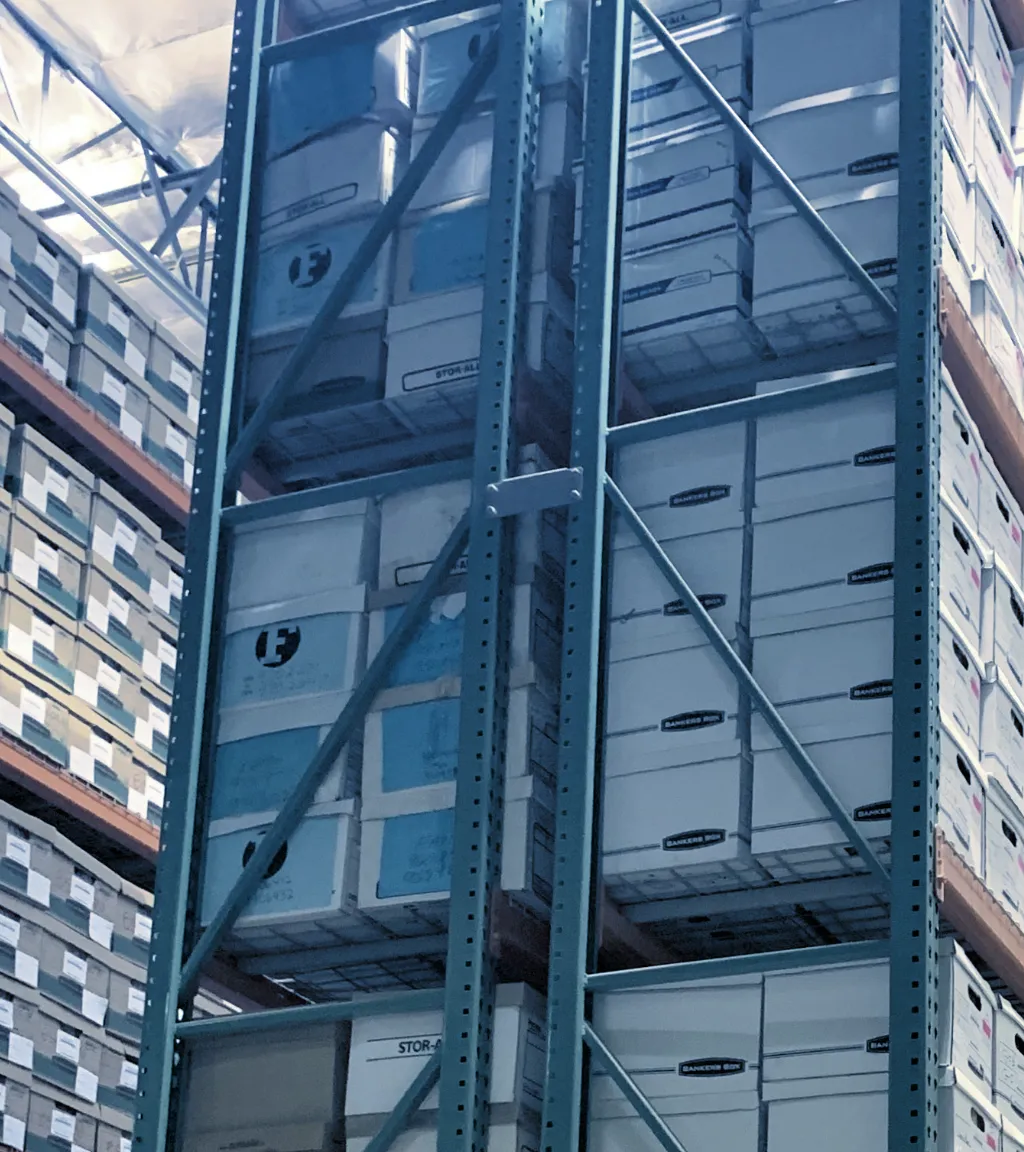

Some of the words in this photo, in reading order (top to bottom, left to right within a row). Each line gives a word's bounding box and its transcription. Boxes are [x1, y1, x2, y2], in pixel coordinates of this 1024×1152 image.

[857, 808, 891, 818] BANKER
[398, 1038, 441, 1054] STOR-A
[682, 1064, 722, 1073] BANKERS
[723, 1062, 741, 1070] BOX
